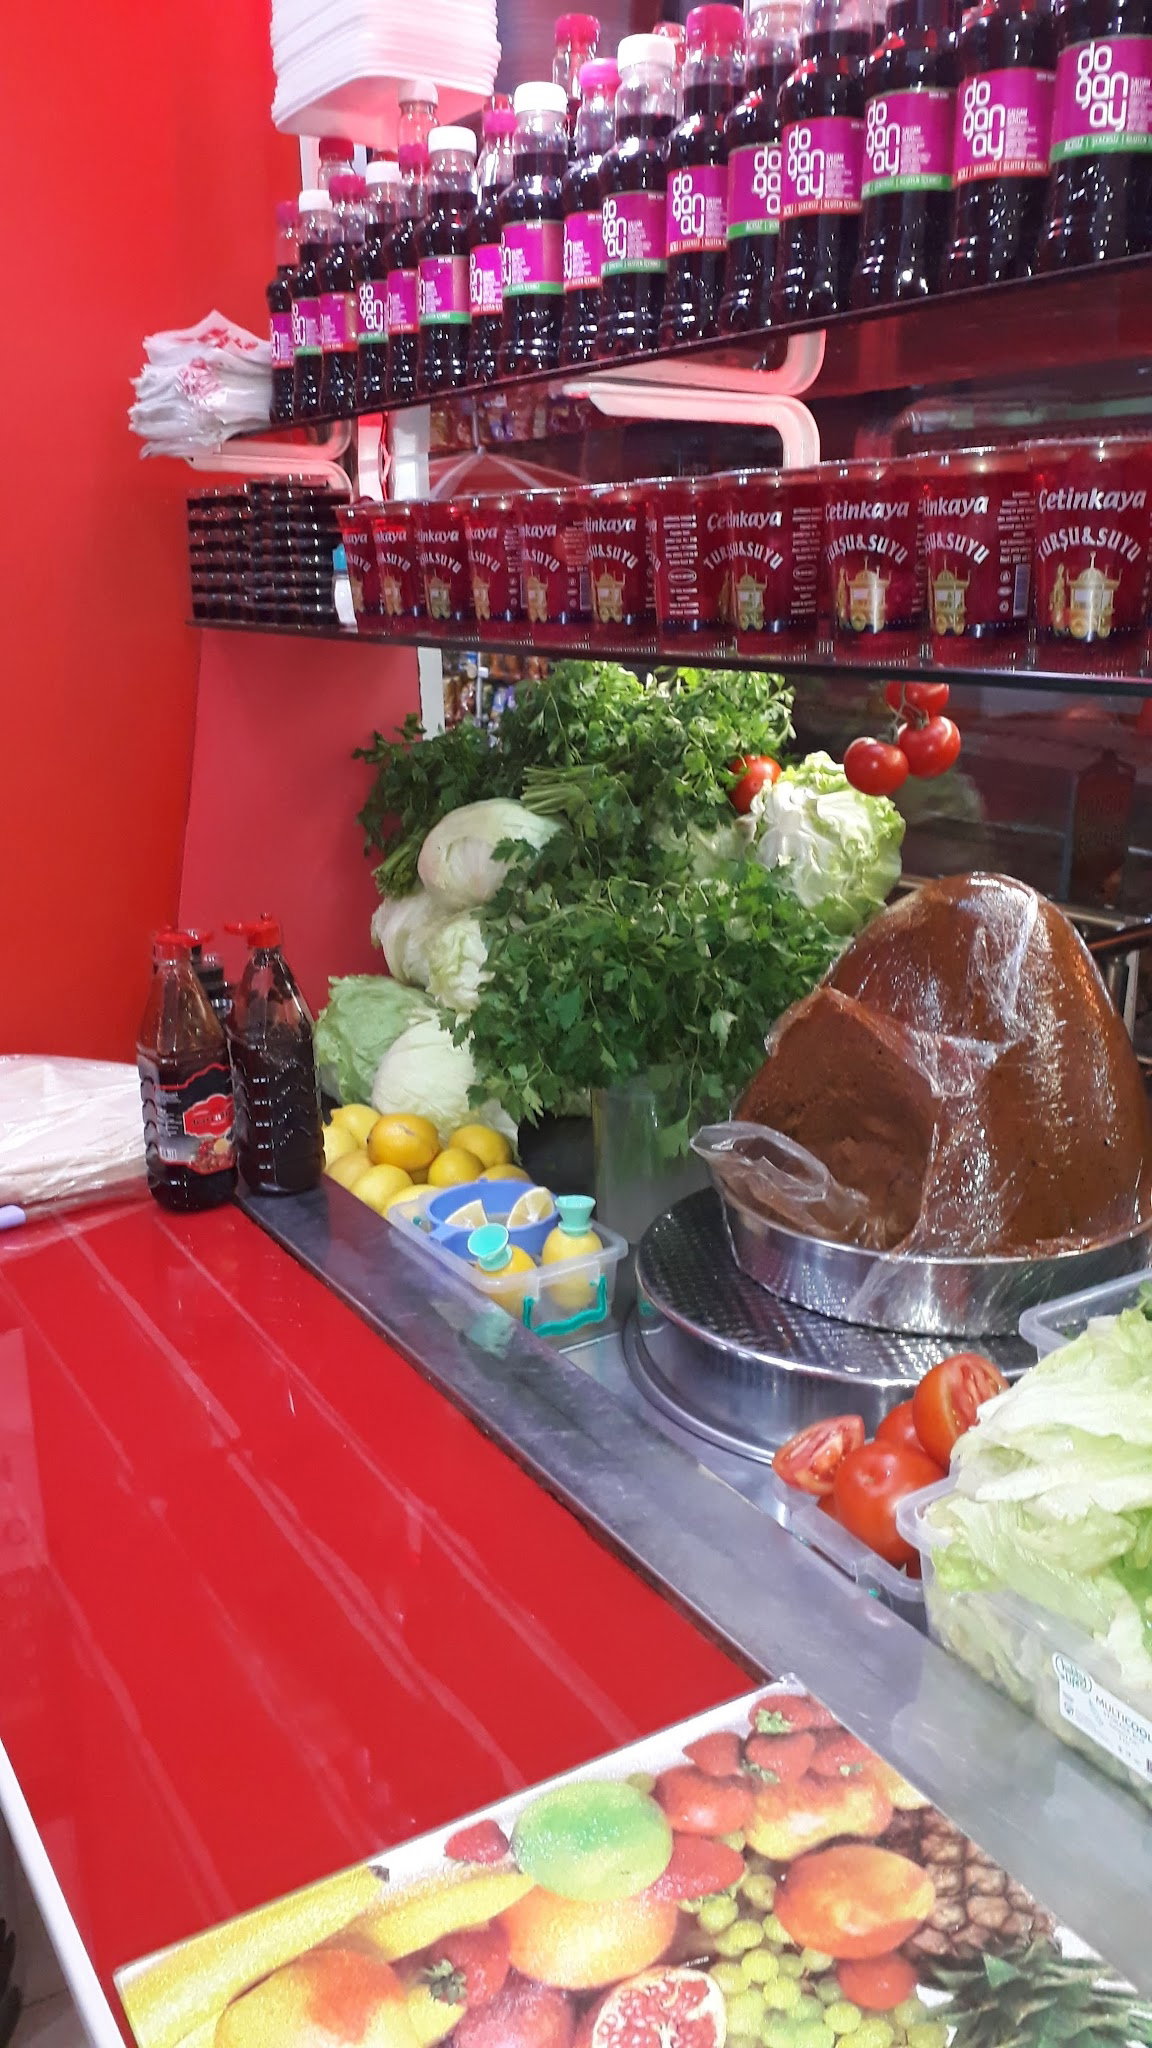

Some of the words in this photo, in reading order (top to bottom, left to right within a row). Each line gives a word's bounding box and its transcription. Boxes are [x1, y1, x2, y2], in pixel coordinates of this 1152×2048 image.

[1078, 41, 1112, 76] do
[965, 78, 991, 108] do
[867, 100, 887, 127] do
[1089, 100, 1127, 132] ay
[788, 125, 811, 152] do
[972, 130, 1004, 161] ay
[873, 148, 900, 177] ay
[673, 171, 692, 197] do
[753, 171, 781, 199] ga
[797, 172, 825, 200] ay
[602, 197, 617, 221] do
[766, 194, 780, 216] a
[680, 214, 705, 238] ay
[1039, 487, 1147, 515] Çetinkaya
